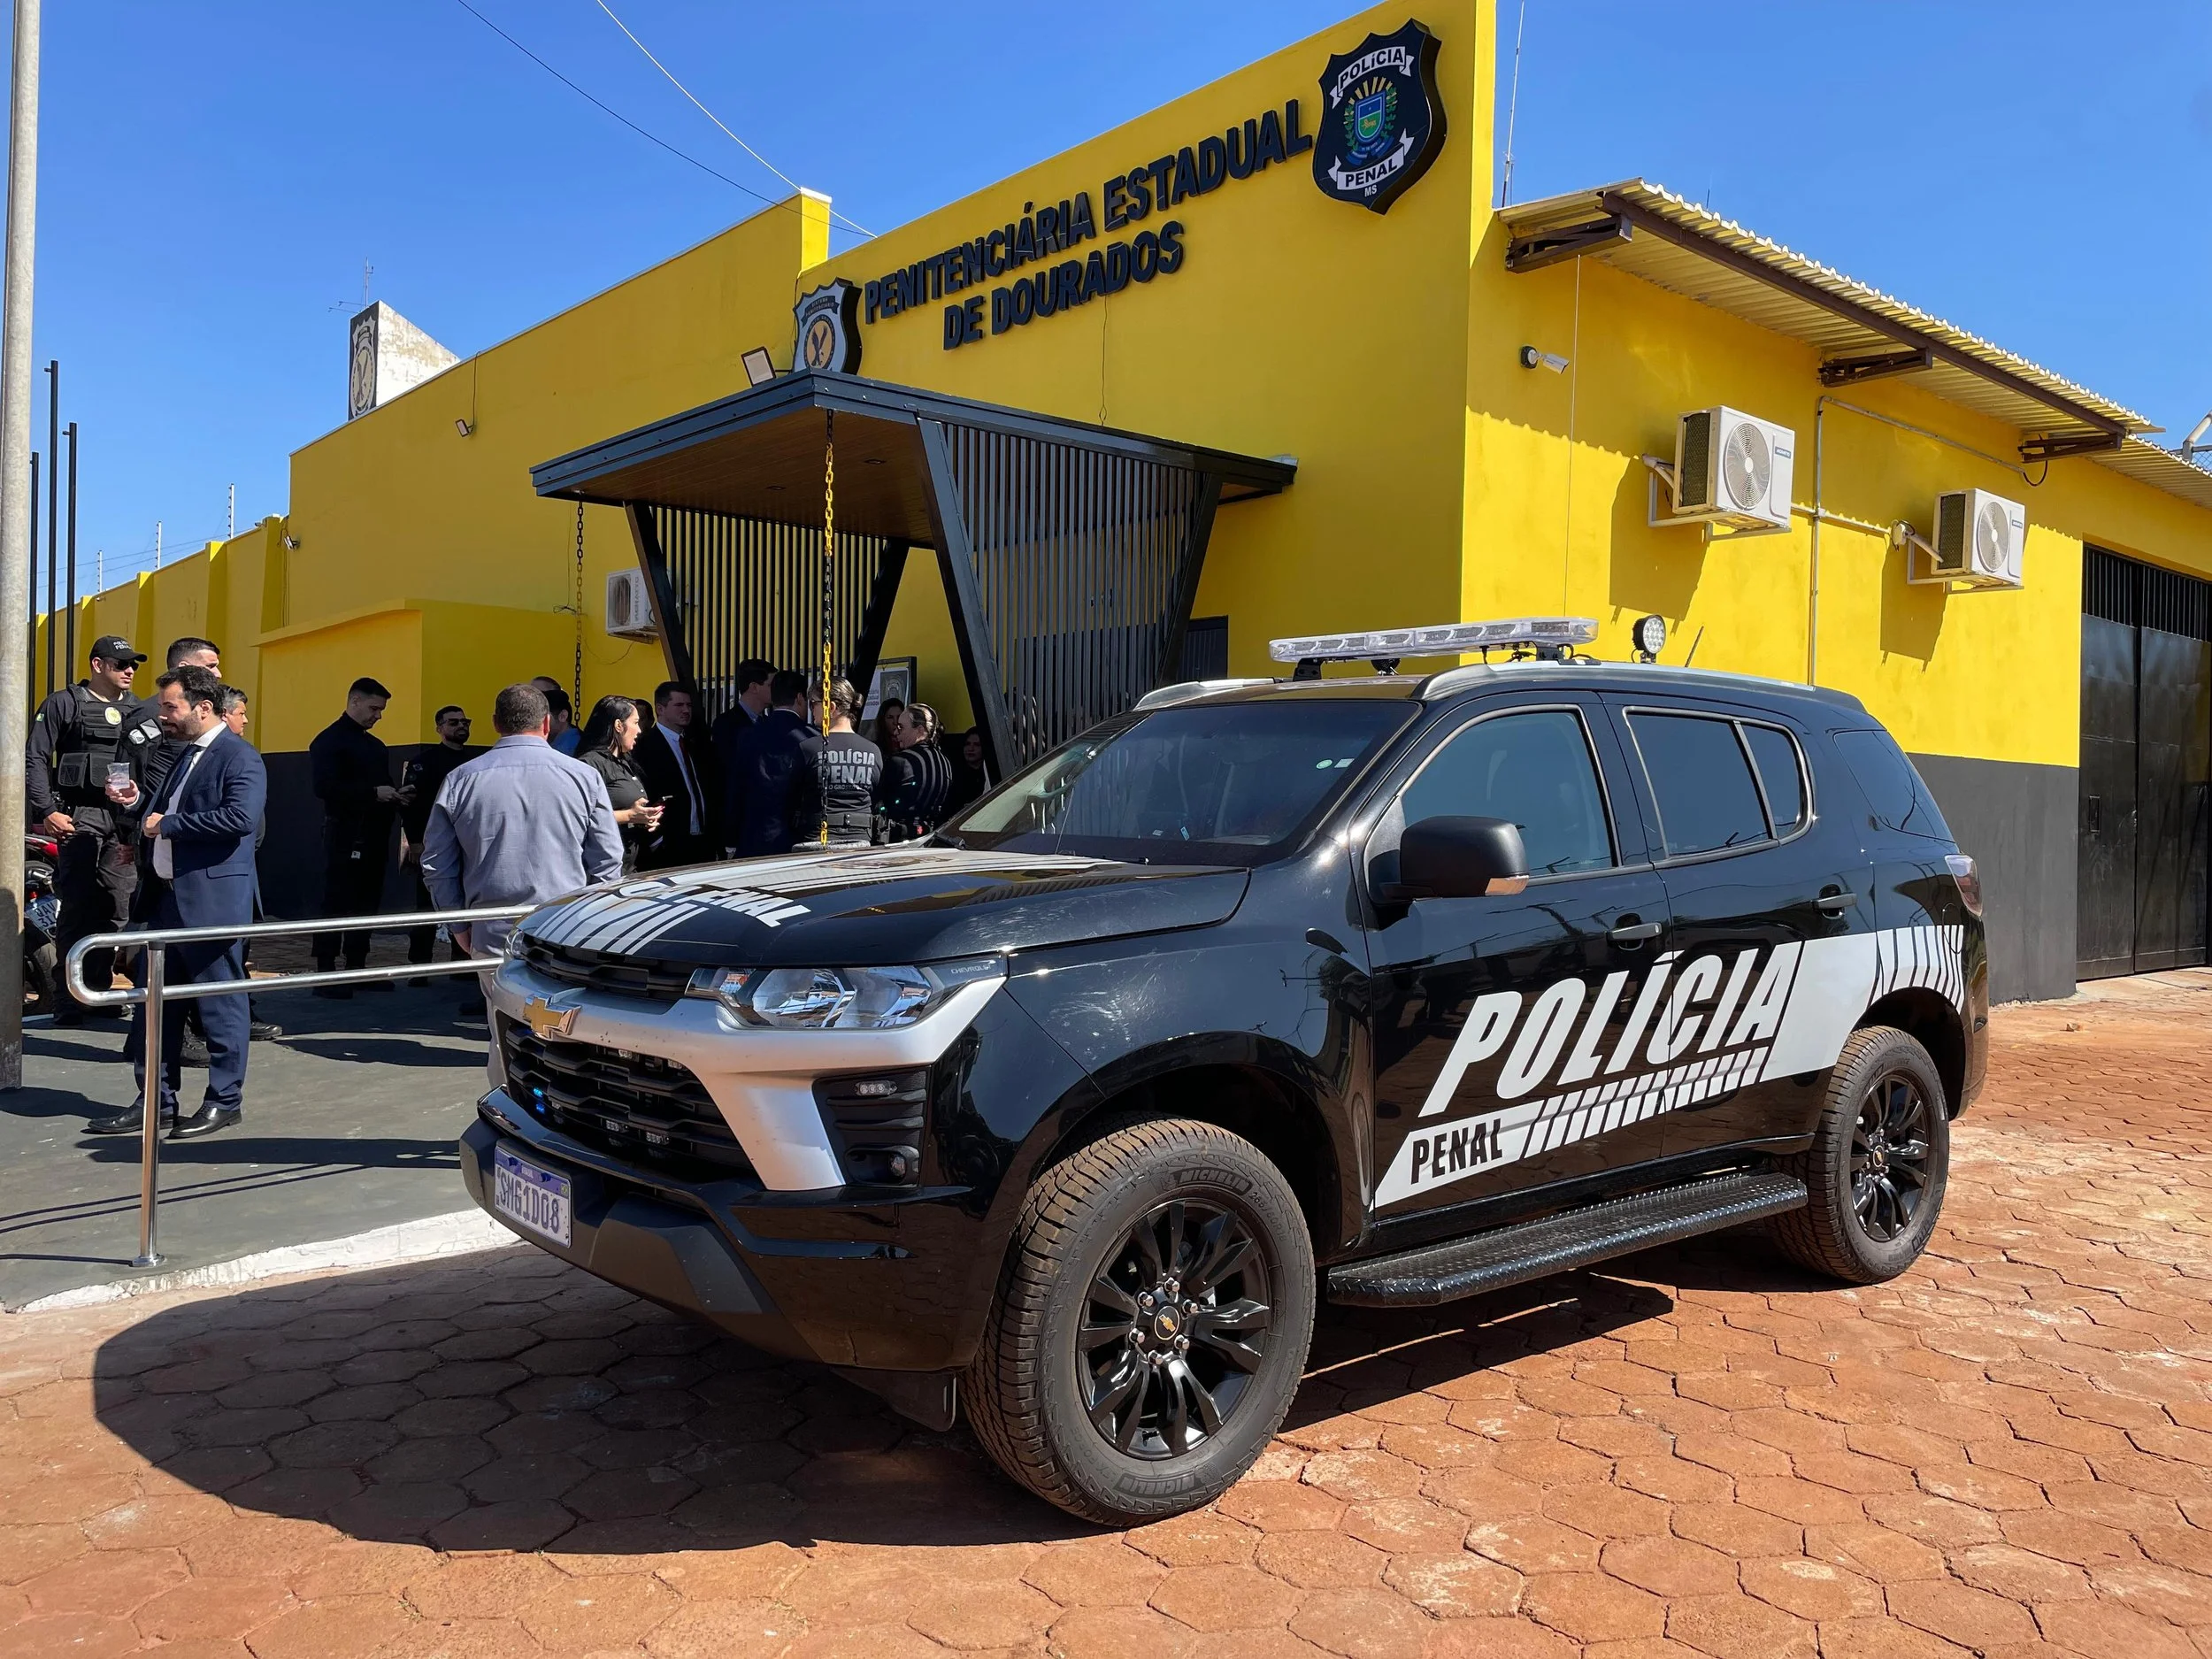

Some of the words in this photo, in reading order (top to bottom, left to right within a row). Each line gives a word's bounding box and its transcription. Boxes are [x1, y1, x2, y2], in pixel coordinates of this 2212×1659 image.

[1340, 48, 1403, 87] POLÍCIA
[1345, 158, 1397, 187] PENAL
[1364, 184, 1377, 197] MS
[864, 192, 1095, 325] PENITENCIÁRIA
[1103, 98, 1313, 232] ESTADUAL
[943, 295, 987, 350] DE
[991, 220, 1184, 335] DOURADOS
[818, 749, 875, 765] POLÍCIA
[950, 964, 991, 974] CHEVROLET
[1418, 941, 1802, 1118] POLÍCIA
[1411, 1118, 1502, 1185] PENAL
[1179, 1168, 1250, 1193] MICHELIN
[1119, 1473, 1194, 1494] MICHELIN
